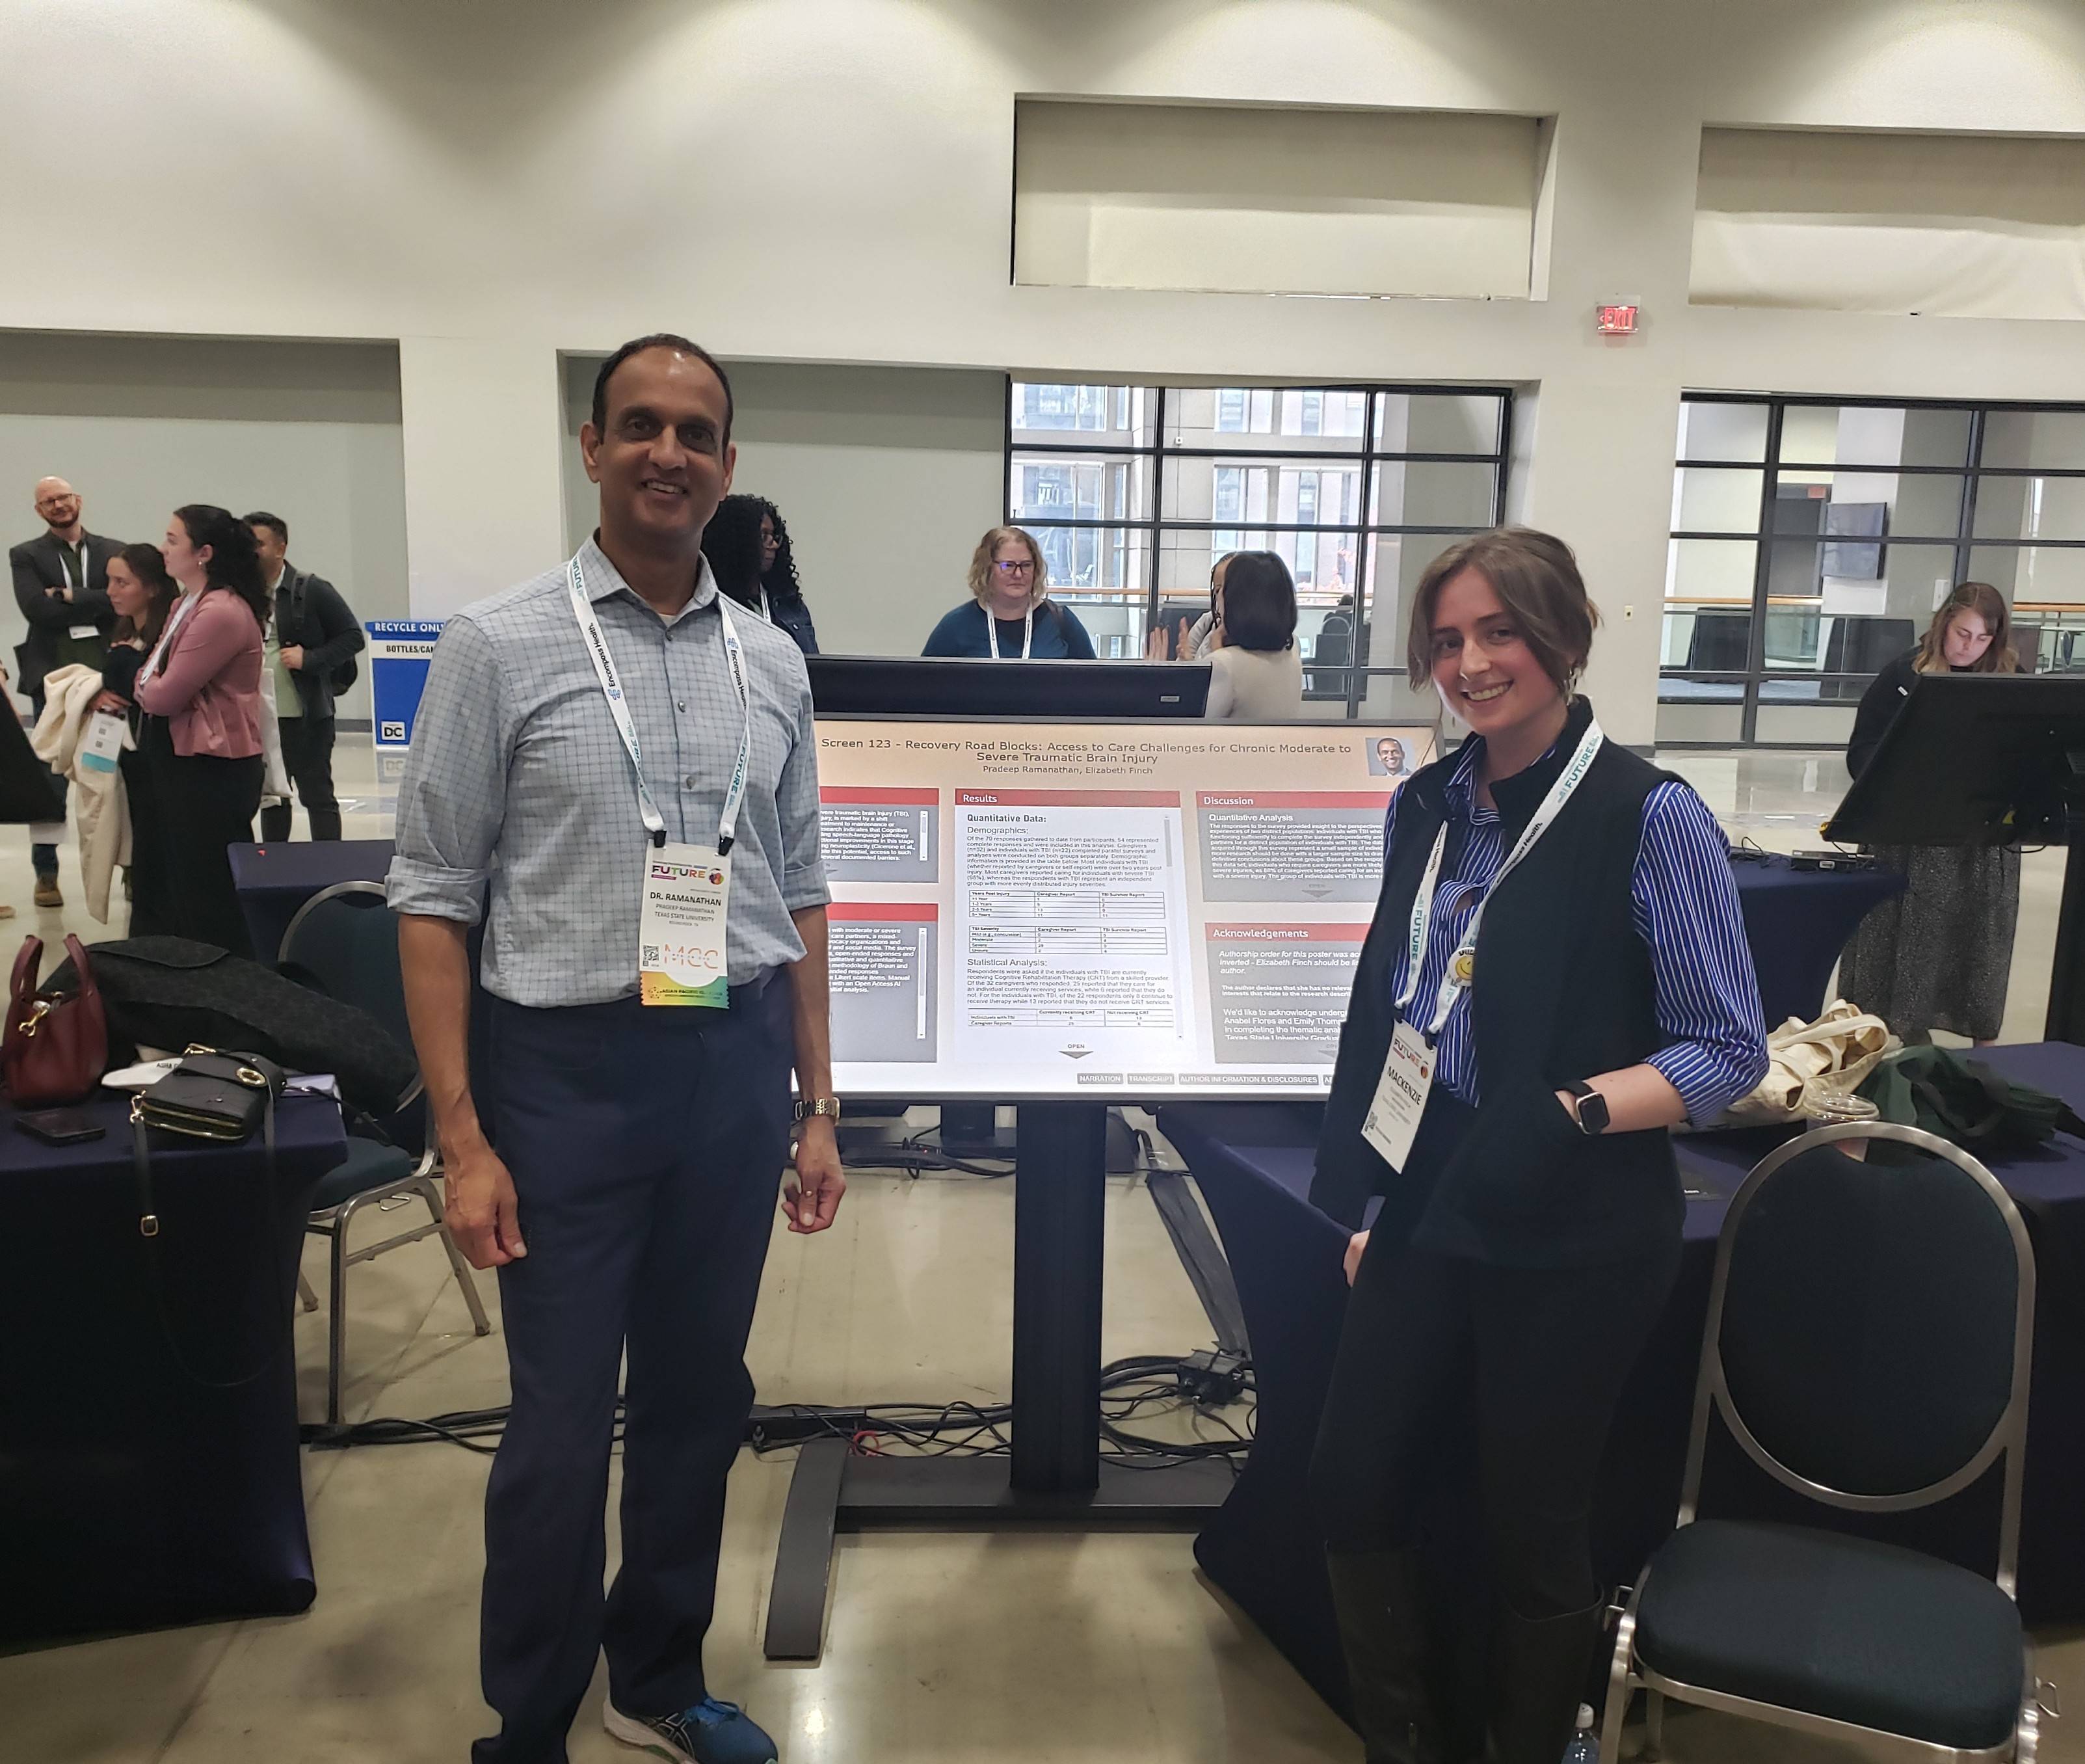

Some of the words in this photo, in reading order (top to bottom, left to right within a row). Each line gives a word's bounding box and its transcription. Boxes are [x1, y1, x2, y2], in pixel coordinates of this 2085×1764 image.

[1604, 308, 1635, 330] EXIT
[375, 623, 416, 632] RECYCLE
[598, 648, 616, 688] Encompass
[730, 650, 742, 686] Encompass
[384, 727, 402, 737] DC
[822, 739, 864, 749] Screen
[869, 740, 891, 749] 123
[905, 740, 960, 752] Recovery
[965, 740, 994, 750] Road
[1000, 741, 1041, 751] Blocks:
[1046, 741, 1087, 751] Access
[1092, 742, 1103, 751] to
[1108, 742, 1135, 751] Care
[1140, 742, 1204, 754] Challenges
[1210, 743, 1225, 752] for
[1230, 743, 1274, 753] Chronic
[1279, 743, 1334, 753] Moderate
[1339, 744, 1350, 753] to
[977, 753, 1018, 762] Severe
[1024, 753, 1082, 762] Traumatic
[1087, 753, 1117, 762] Brain
[1122, 754, 1157, 765] Injury
[731, 746, 746, 794] FUTURE
[984, 766, 1019, 775] Pradeep
[1023, 766, 1082, 775] Ramanathan,
[1565, 745, 1594, 788] FUTURE
[963, 794, 998, 803] Results
[1204, 796, 1254, 805] Discussion
[1259, 814, 1293, 823] Analysis
[967, 826, 1029, 835] Demographics:
[652, 865, 706, 879] FUTURE
[666, 893, 721, 906] RAMANATHAN
[1213, 929, 1308, 939] Acknowledgements
[1412, 910, 1423, 961] FUTURE
[1219, 951, 1258, 959] Authorship
[1308, 951, 1331, 959] poster
[1009, 959, 1047, 968] Analysis:
[1268, 1009, 1316, 1017] acknowledge
[1293, 1018, 1314, 1026] Emily
[1394, 1039, 1420, 1065] FUTURE
[1387, 1066, 1422, 1106] MACKENZIE
